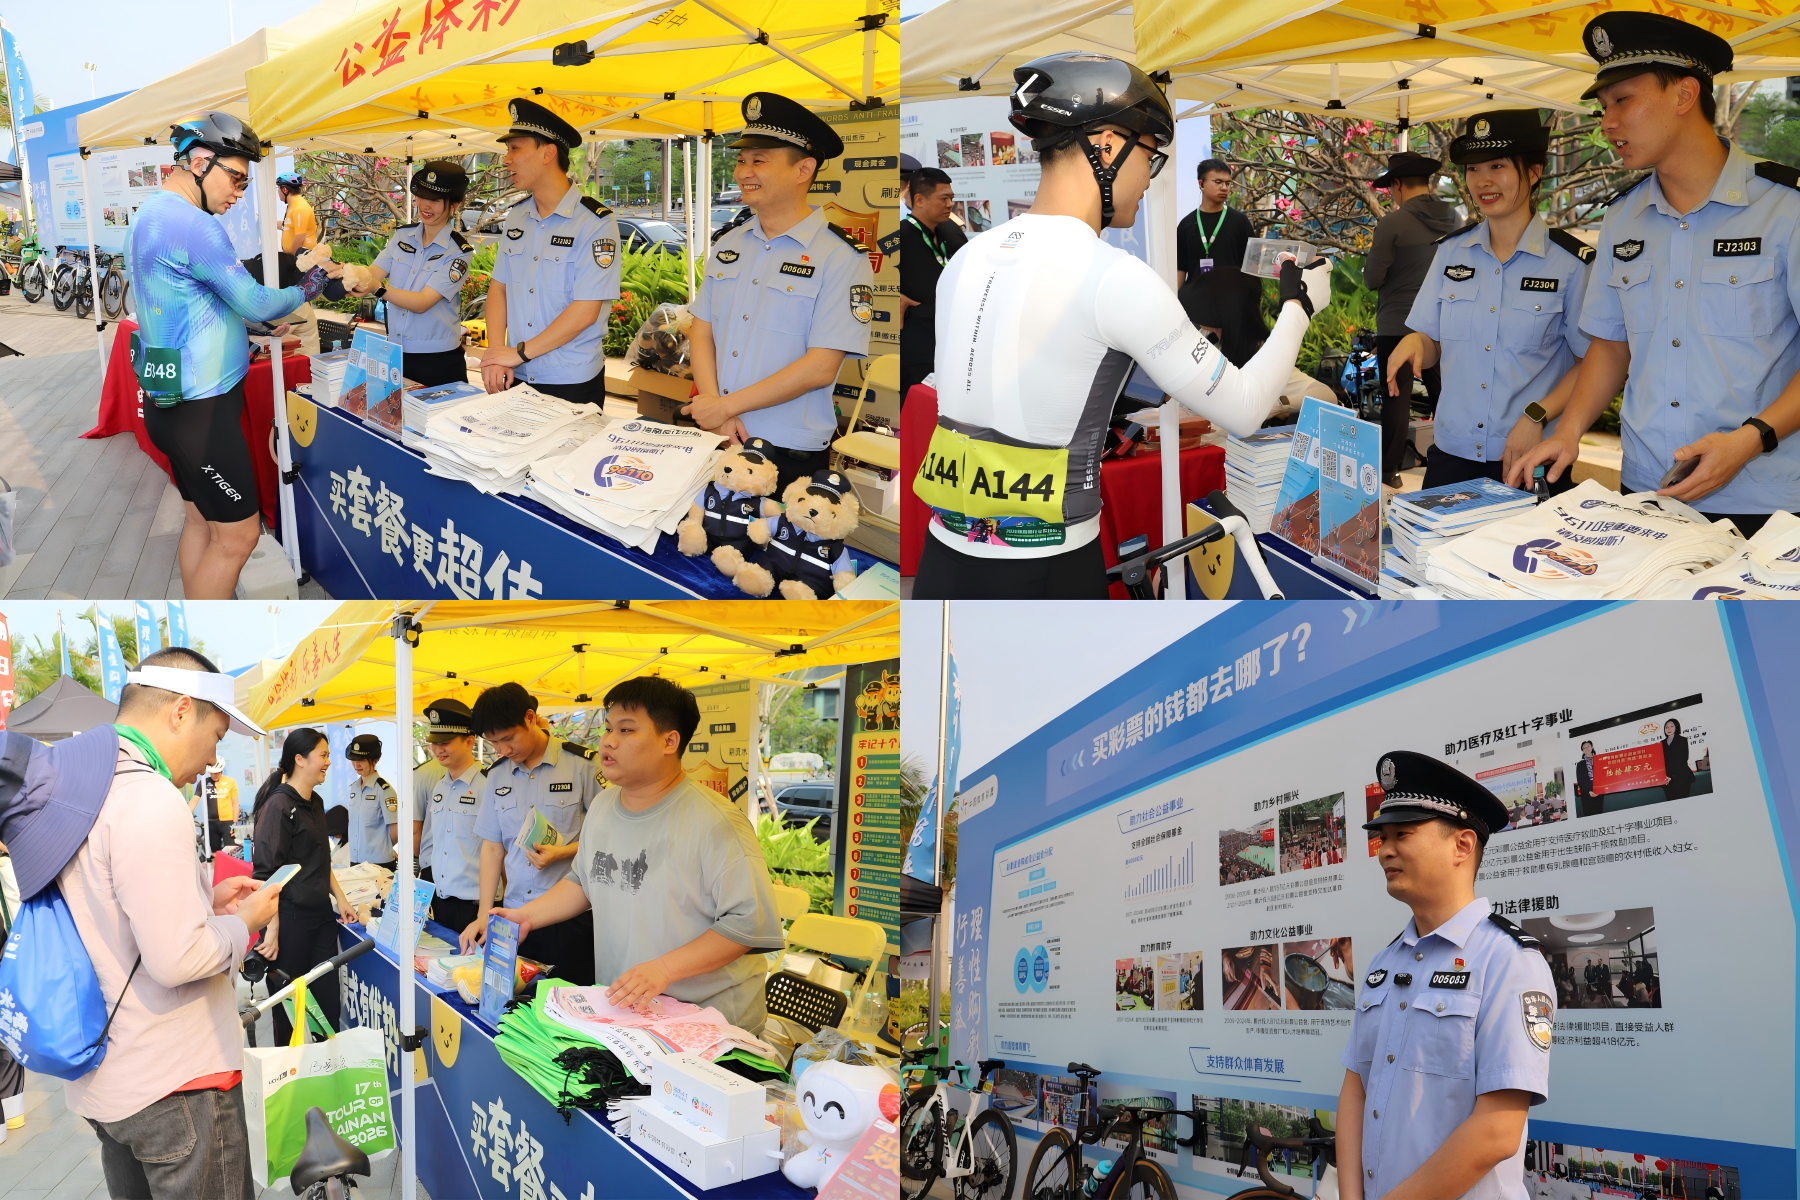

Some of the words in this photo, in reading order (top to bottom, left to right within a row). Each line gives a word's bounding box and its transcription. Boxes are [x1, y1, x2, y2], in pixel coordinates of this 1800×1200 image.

[1716, 241, 1757, 254] FJ2303
[782, 264, 812, 276] 005083
[1523, 279, 1555, 290] FJ2304
[606, 464, 654, 482] 96110
[970, 466, 1054, 502] A144
[1092, 622, 1312, 766] 买彩票的钱都去哪了？
[1445, 708, 1574, 756] 助力医疗及红十字事业
[1254, 789, 1300, 812] 助力乡村振兴
[1250, 924, 1313, 941] 助力文化公益事业
[1433, 974, 1466, 985] 005083
[1206, 1055, 1285, 1073] 支持群众体育发展
[355, 1082, 370, 1095] 17
[325, 1099, 366, 1123] TOUR
[332, 1111, 385, 1135] AINAN
[348, 1125, 388, 1147] 2026
[470, 1096, 595, 1200] 买套餐
